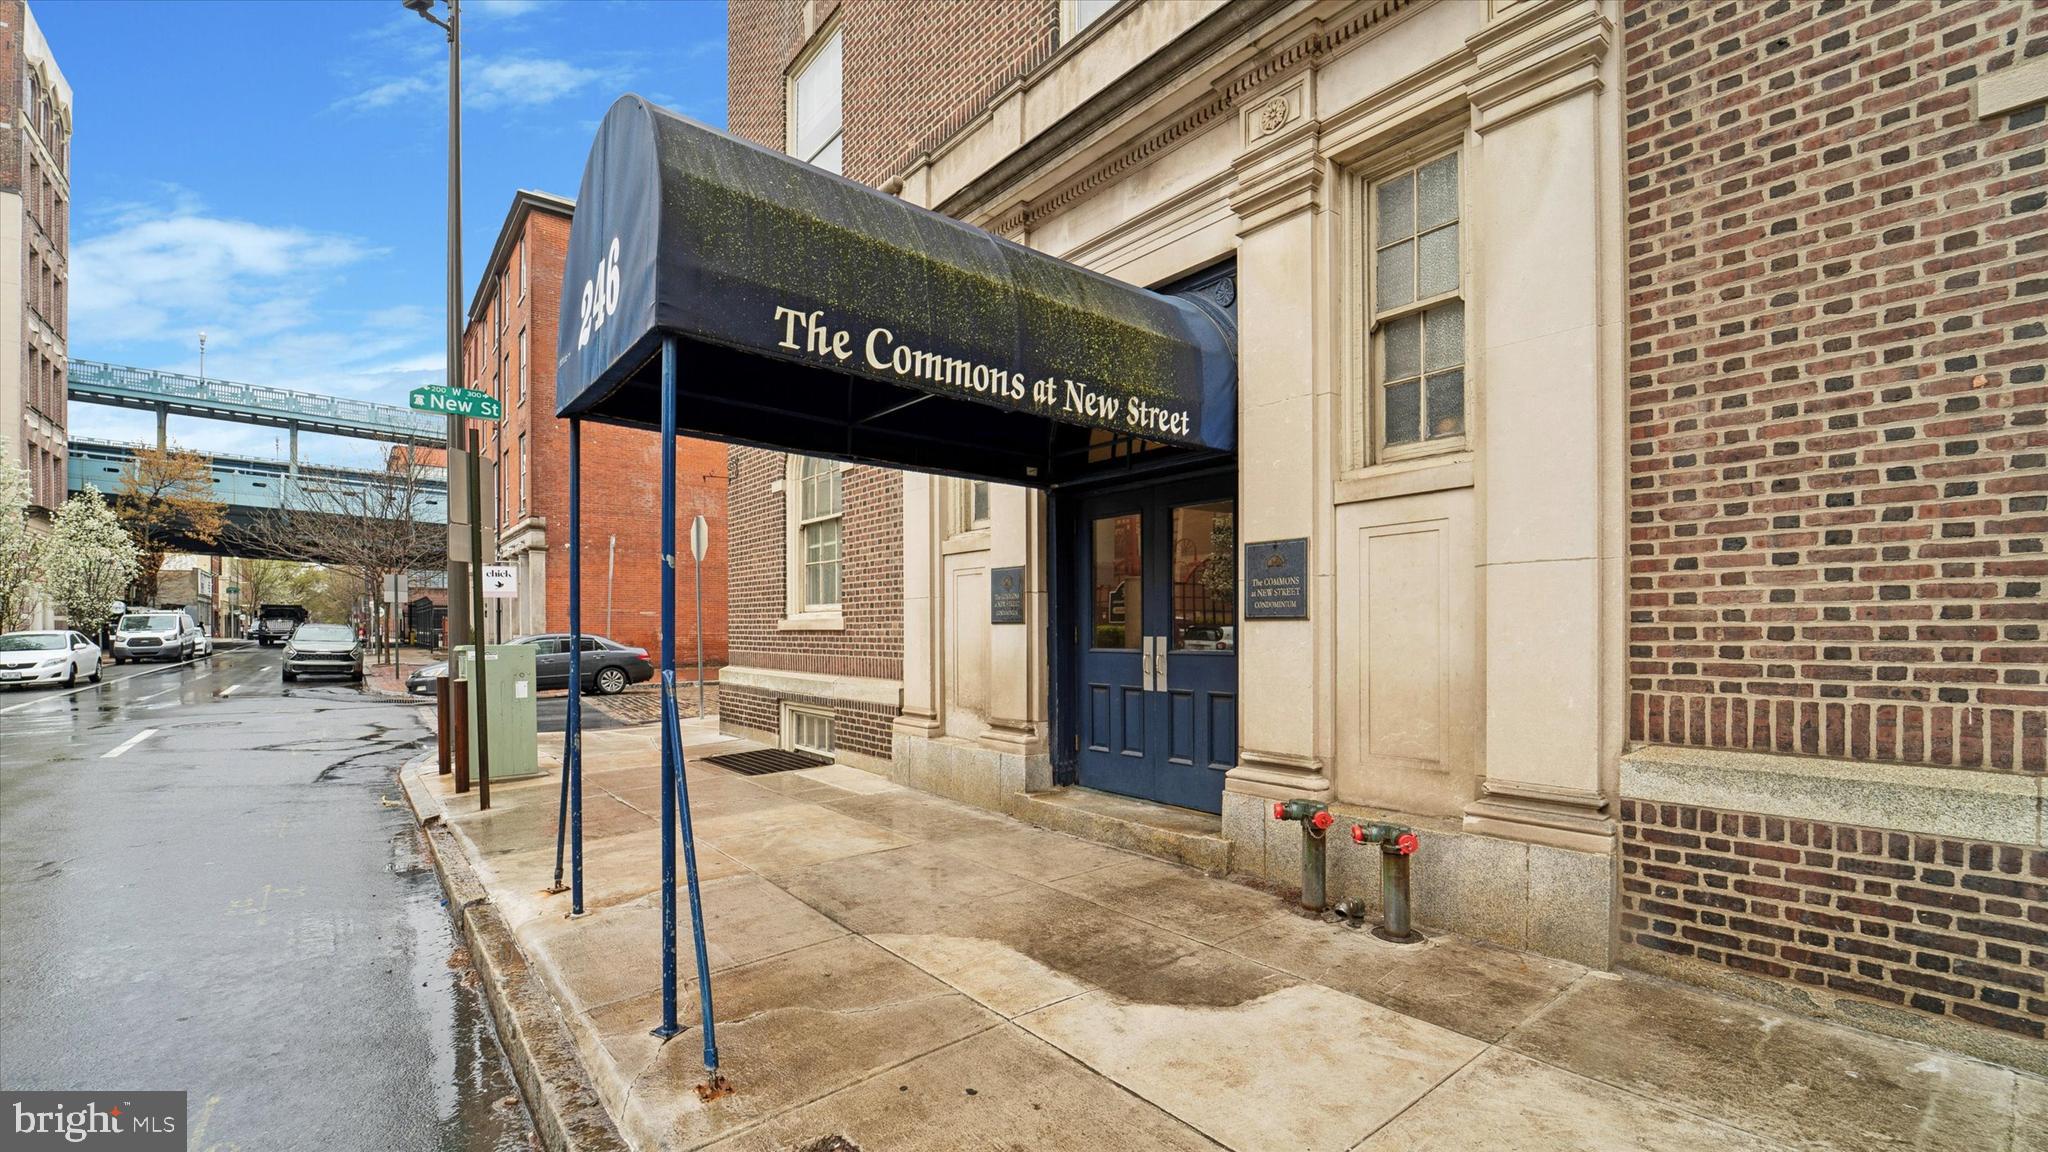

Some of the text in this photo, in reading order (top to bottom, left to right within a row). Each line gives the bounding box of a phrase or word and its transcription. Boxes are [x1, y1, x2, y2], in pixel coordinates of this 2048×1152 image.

[578, 237, 620, 351] 246
[774, 305, 1190, 436] The Commons at New Street
[431, 386, 447, 394] 200
[452, 388, 462, 396] W
[430, 394, 499, 416] New St
[485, 569, 512, 578] chick
[1252, 576, 1300, 586] The COMMONS
[1257, 588, 1273, 597] NEW
[1273, 587, 1300, 596] STREET
